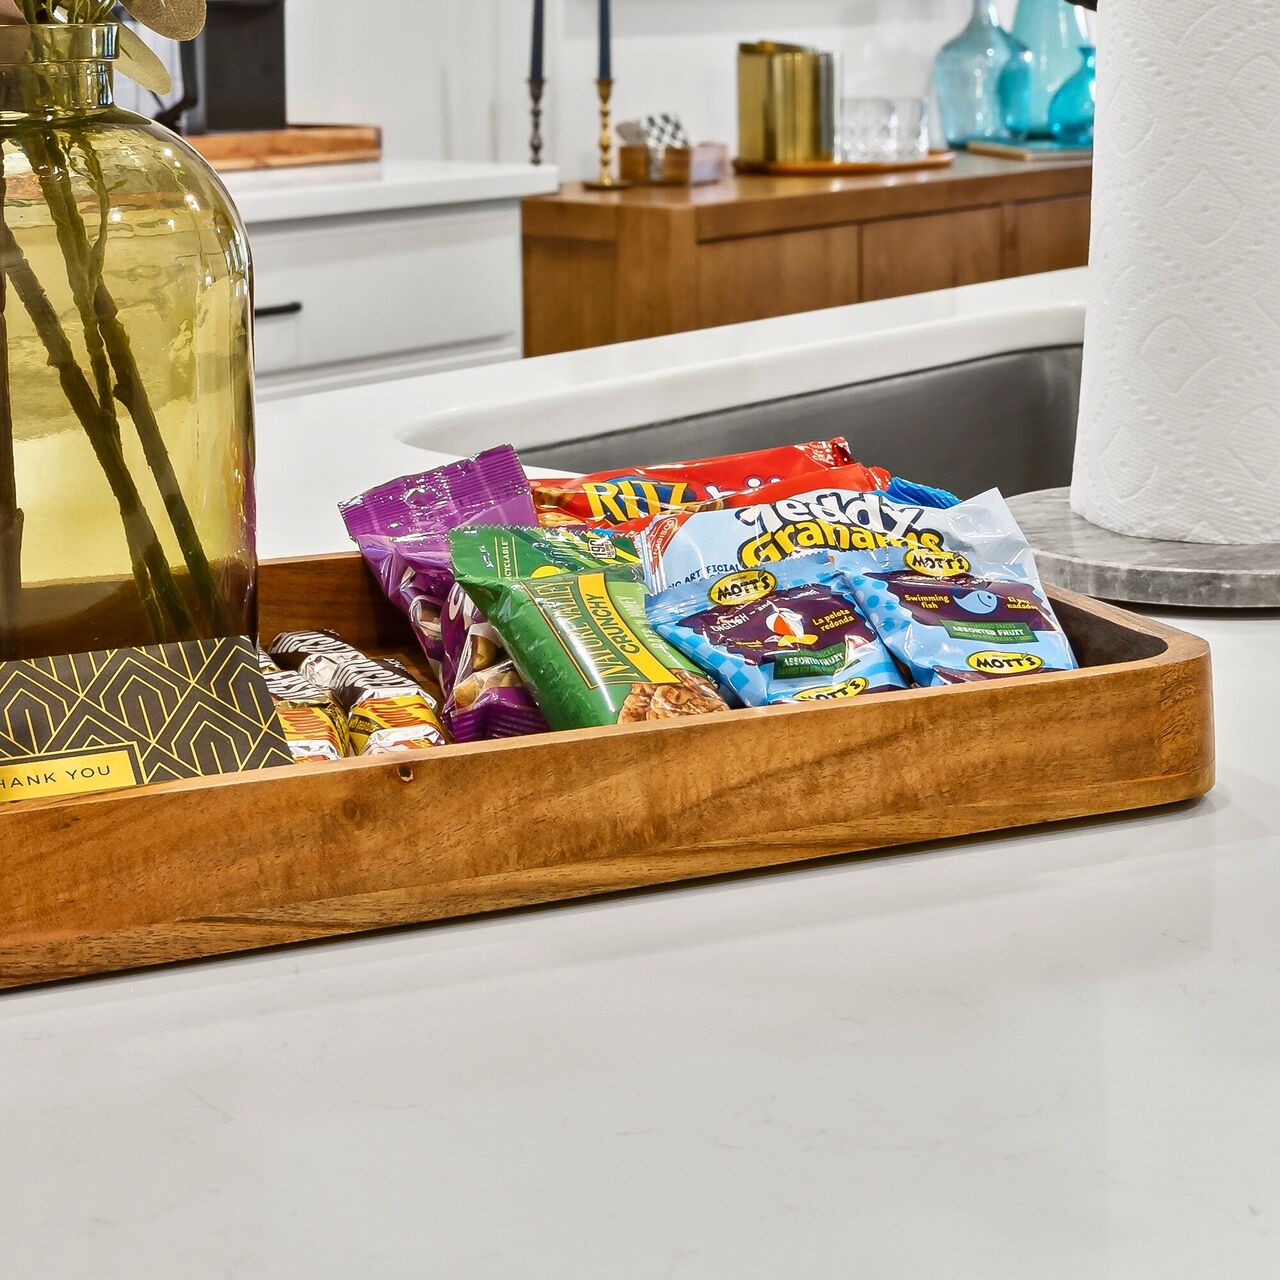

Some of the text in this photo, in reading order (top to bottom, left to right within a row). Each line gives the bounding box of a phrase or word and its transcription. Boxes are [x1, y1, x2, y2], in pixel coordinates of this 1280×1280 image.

[581, 480, 688, 523] RITZ
[737, 492, 922, 537] Teddy
[739, 519, 945, 569] Grahams
[503, 540, 512, 579] CYCLABLE
[684, 563, 740, 584] ARTFICIAL
[716, 575, 773, 602] MOTT'S
[904, 594, 950, 604] Swimming
[921, 601, 939, 610] fish
[585, 593, 641, 654] CRUNCHY
[812, 608, 851, 627] La pelota
[820, 615, 855, 632] redonda
[976, 657, 1038, 669] MOTT'S
[65, 765, 112, 781] YOU
